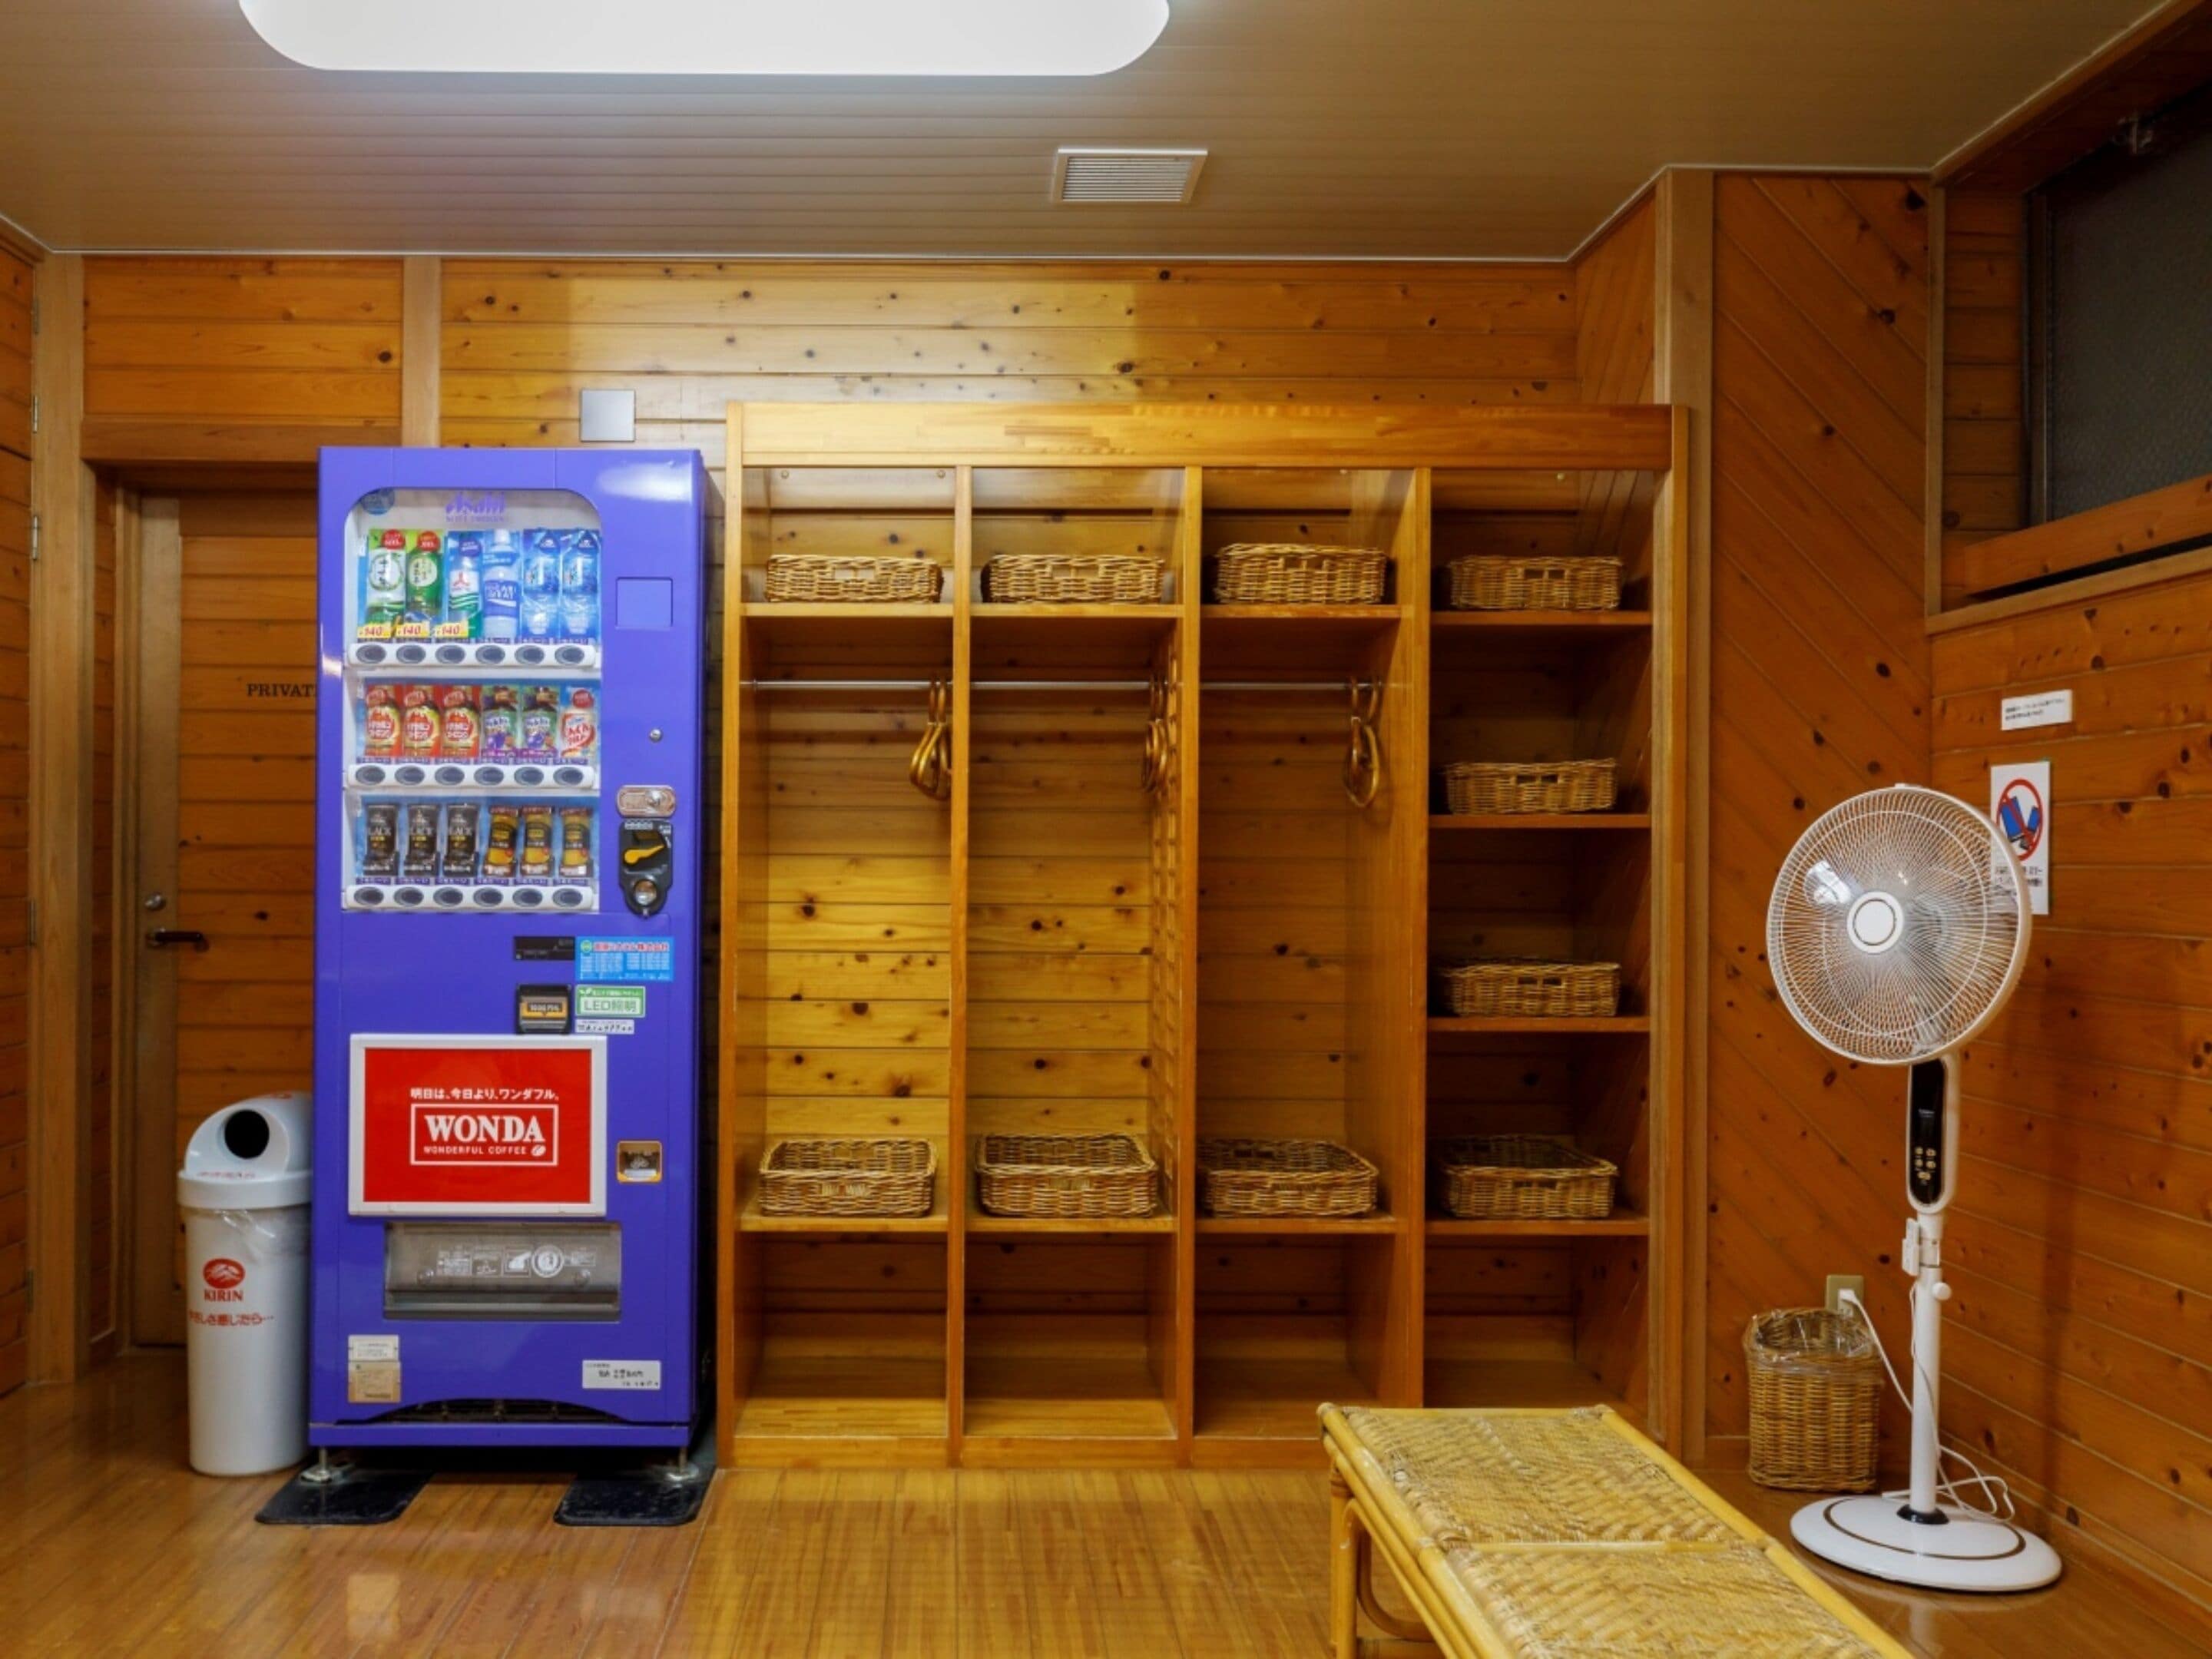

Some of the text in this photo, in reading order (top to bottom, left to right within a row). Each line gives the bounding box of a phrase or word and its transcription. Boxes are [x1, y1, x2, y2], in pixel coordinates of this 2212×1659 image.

[247, 683, 316, 697] PRIVAT
[410, 1088, 560, 1101] 明日は、今日より、ワンダフル。
[424, 1114, 546, 1143] WONDA
[424, 1146, 527, 1155] WONDERFUL COFFEE
[204, 1289, 243, 1302] KIRIN
